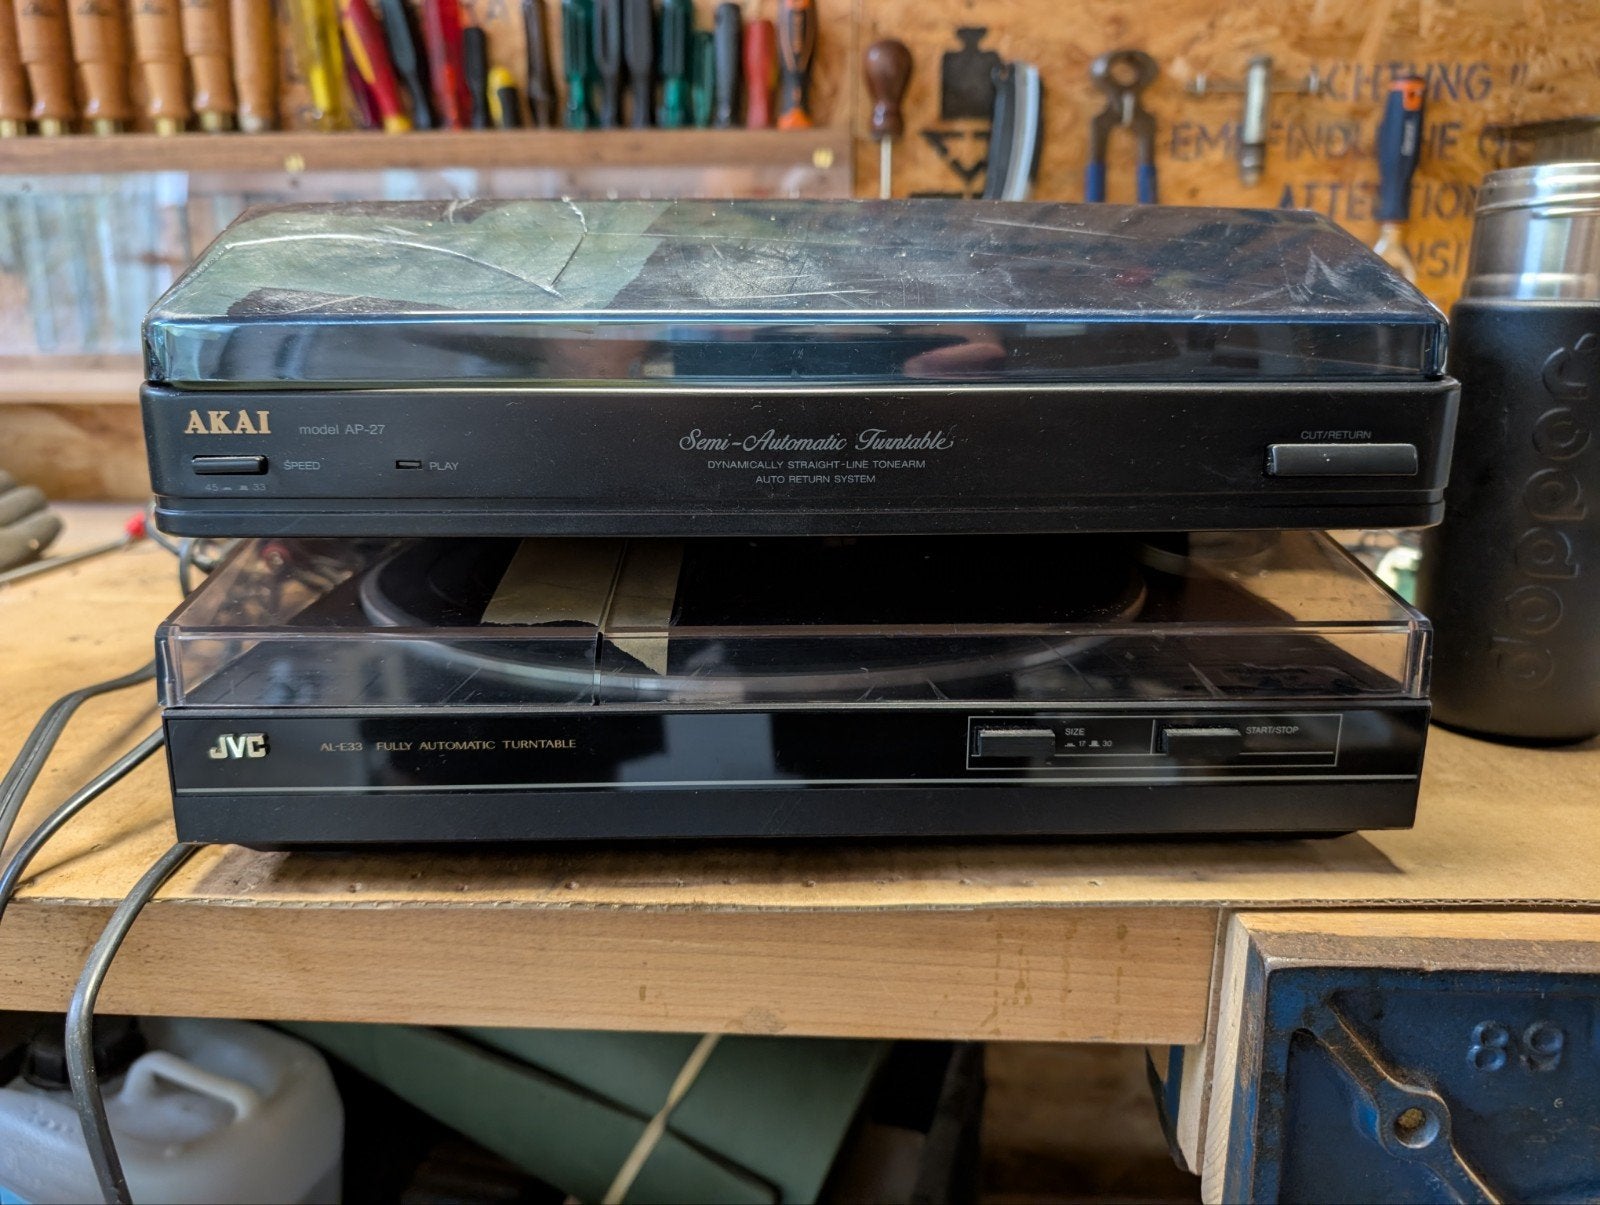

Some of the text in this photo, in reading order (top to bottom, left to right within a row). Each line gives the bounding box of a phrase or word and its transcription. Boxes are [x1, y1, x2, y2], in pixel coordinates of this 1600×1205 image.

[184, 409, 271, 436] AKAI
[298, 423, 386, 436] model AP-27
[1300, 429, 1373, 441] CUT/RETURN
[679, 426, 957, 452] Semi-Automatic Turntable
[283, 460, 321, 471] SPEED
[429, 460, 459, 472] PLAY
[707, 458, 926, 471] DYNAMICALLY STRAIGHT-LINE TONEARM
[755, 473, 876, 485] AUTO RETURN SYSTEM
[204, 483, 219, 492] 45
[251, 483, 267, 492] 33
[1064, 727, 1086, 737] SIZE
[1245, 725, 1300, 736] START/STOP
[208, 732, 269, 761] JVC
[320, 738, 577, 753] AL-E33 FULLY AUTOMATIC TURNTABLE
[1078, 739, 1087, 747] 17
[1101, 739, 1114, 747] 30
[1465, 1019, 1565, 1073] 89
